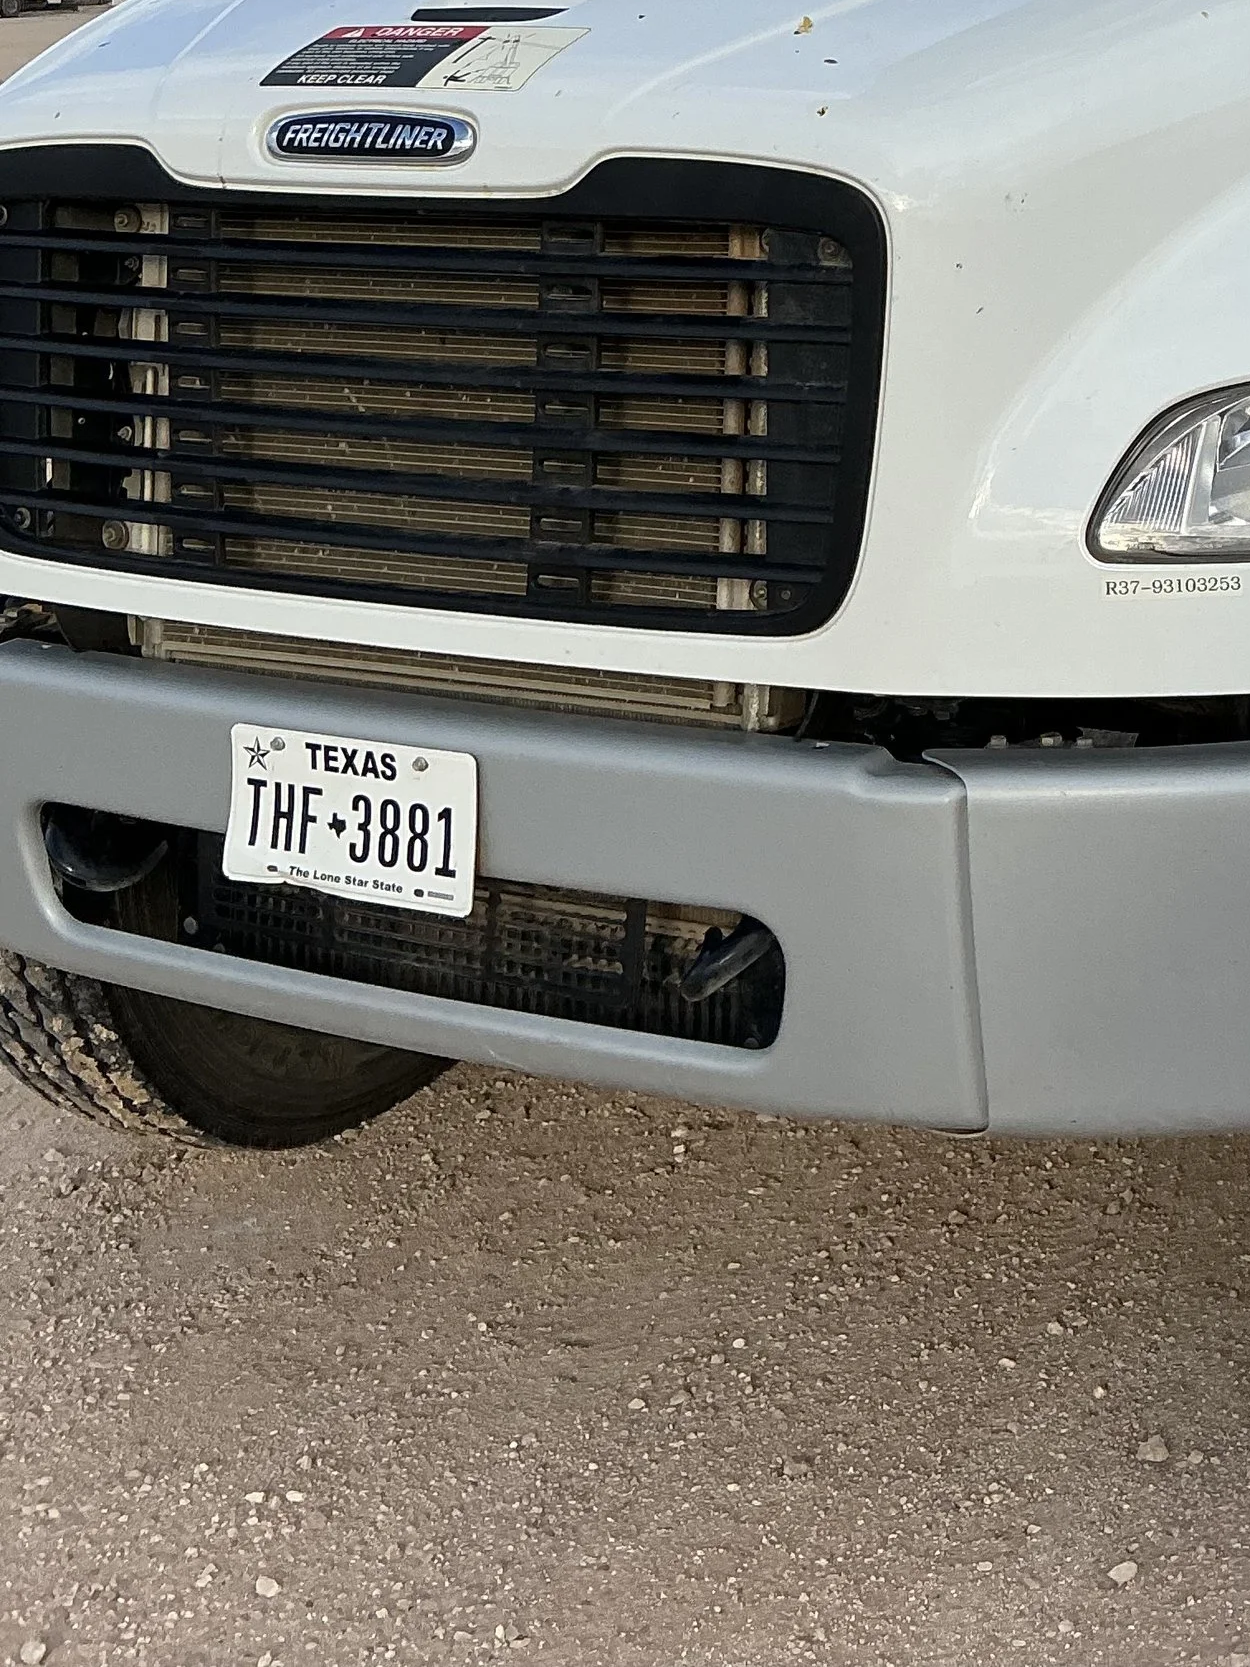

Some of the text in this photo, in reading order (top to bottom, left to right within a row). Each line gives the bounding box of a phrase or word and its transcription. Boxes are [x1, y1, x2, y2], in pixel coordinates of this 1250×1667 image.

[375, 27, 465, 37] DANGER
[297, 74, 387, 85] KEEP CLEAR
[282, 122, 448, 151] FREIGHTLINER
[1105, 576, 1241, 596] R37-93103253
[305, 742, 397, 781] TEXAS
[289, 865, 403, 894] The Lone Star State
